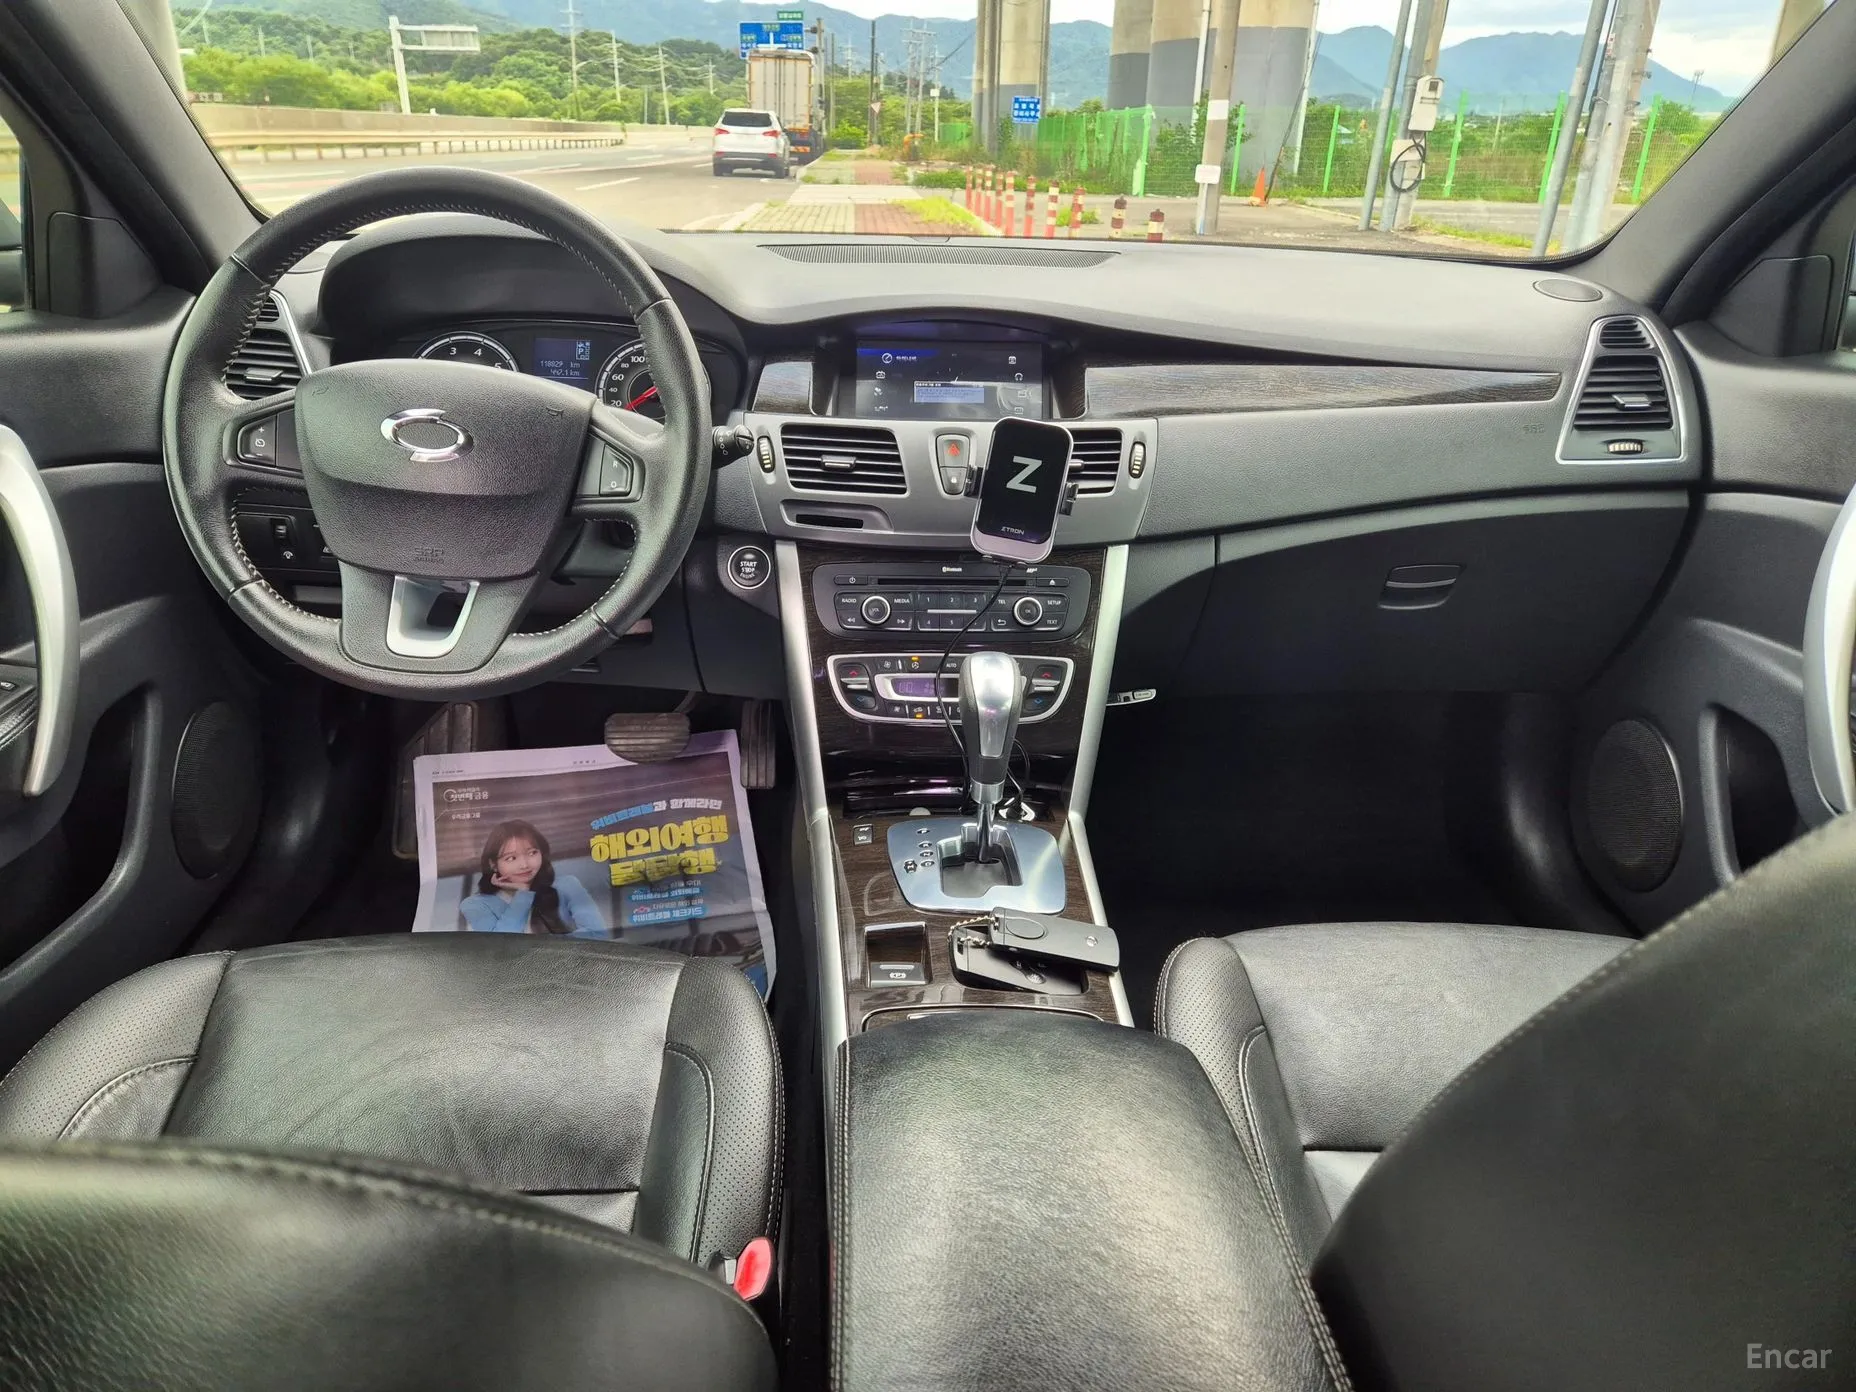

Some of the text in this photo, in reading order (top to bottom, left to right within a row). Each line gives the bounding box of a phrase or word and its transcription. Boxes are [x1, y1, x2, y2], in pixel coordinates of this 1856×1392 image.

[449, 347, 457, 355] 3
[473, 348, 482, 356] 4
[1006, 455, 1043, 494] Z
[669, 798, 723, 811] 함께라면
[589, 814, 730, 863] 해외여행
